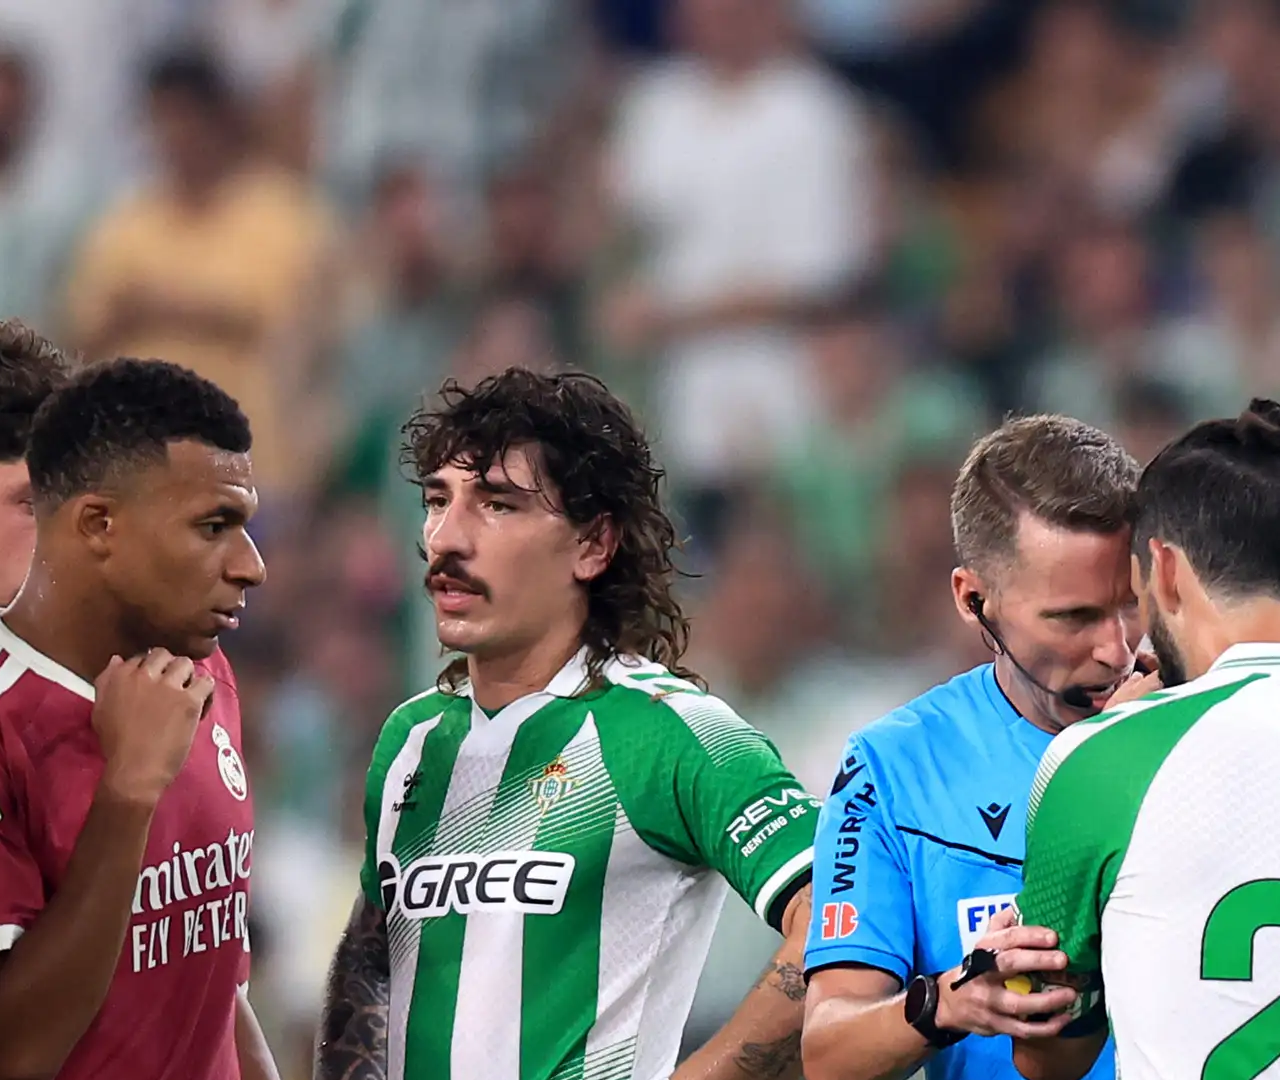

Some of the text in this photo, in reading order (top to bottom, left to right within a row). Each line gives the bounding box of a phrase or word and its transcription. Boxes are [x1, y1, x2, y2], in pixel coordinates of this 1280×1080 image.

[740, 803, 808, 858] RENTING DE
[131, 827, 255, 915] mirate
[403, 859, 566, 911] GREE
[132, 917, 170, 973] FLY
